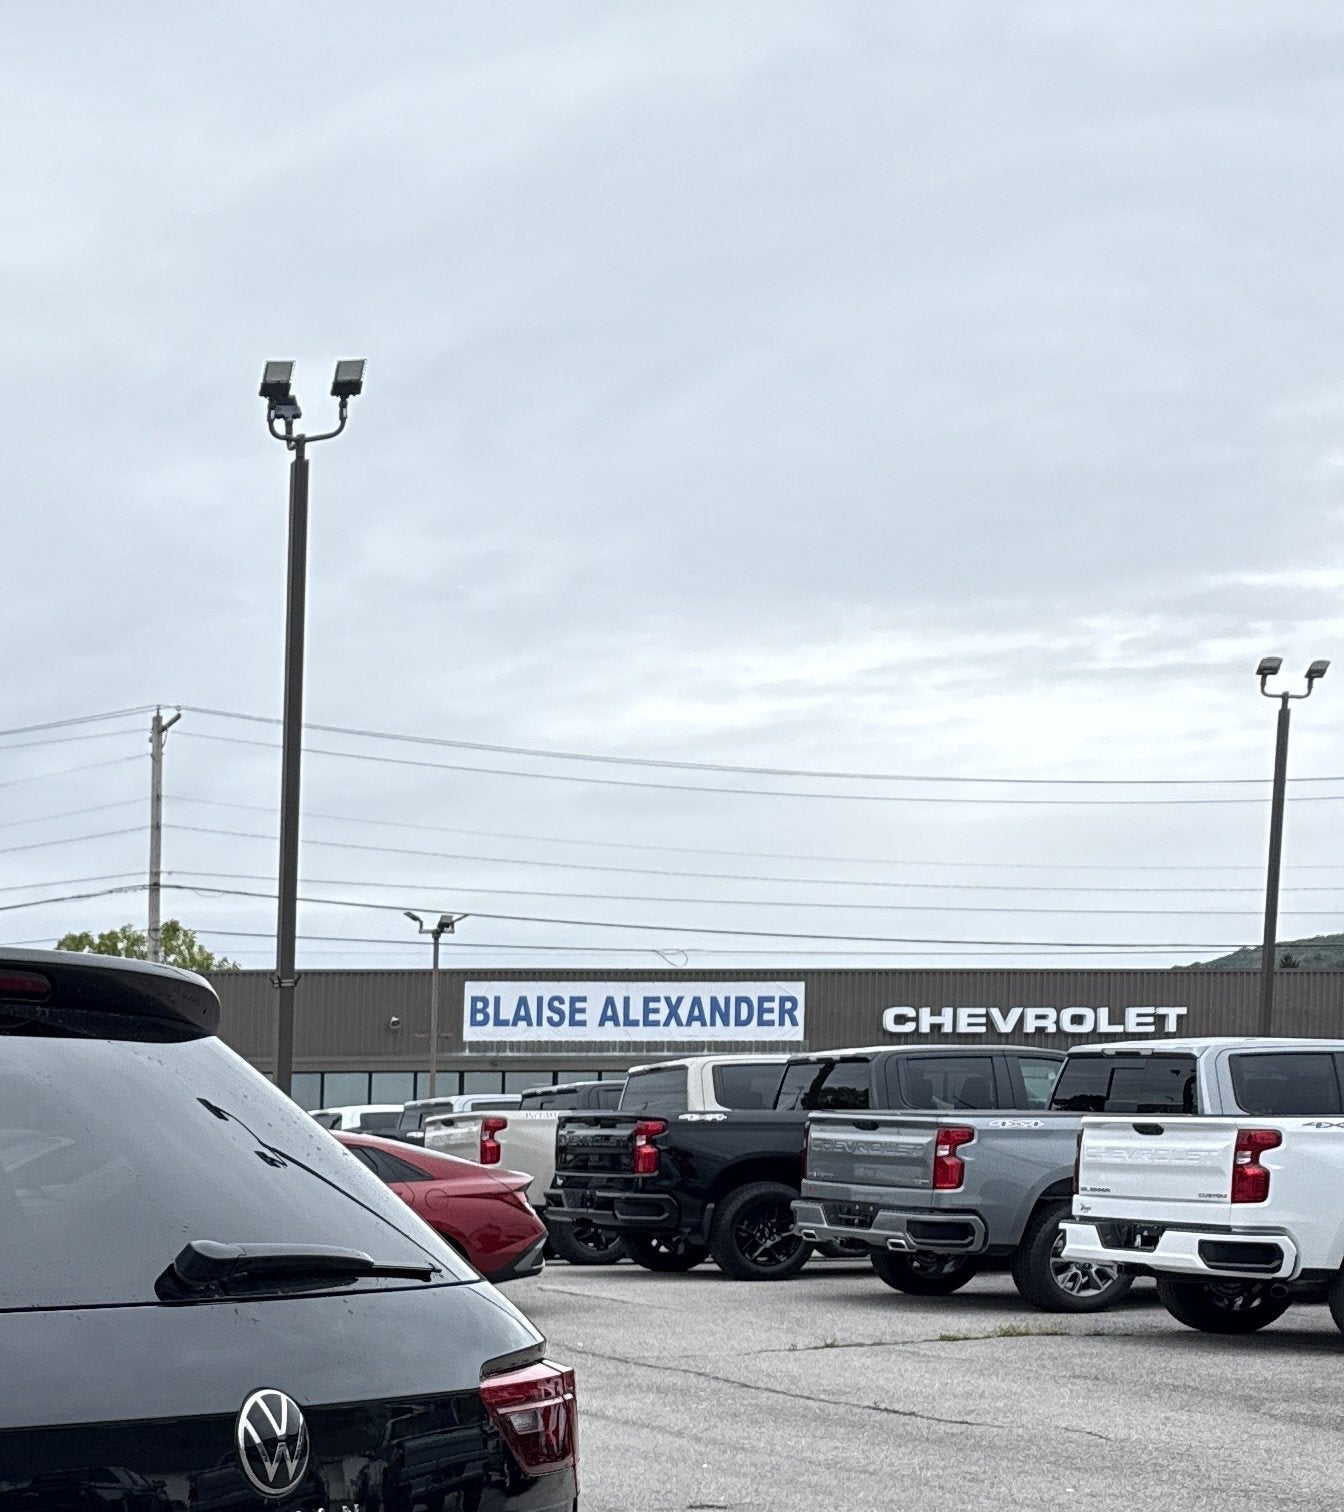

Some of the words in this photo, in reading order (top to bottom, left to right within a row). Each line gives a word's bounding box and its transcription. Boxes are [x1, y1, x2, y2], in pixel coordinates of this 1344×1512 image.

[469, 995, 587, 1027] BLAISE
[598, 995, 800, 1027] ALEXANDER
[882, 1006, 1188, 1034] CHEVROLET
